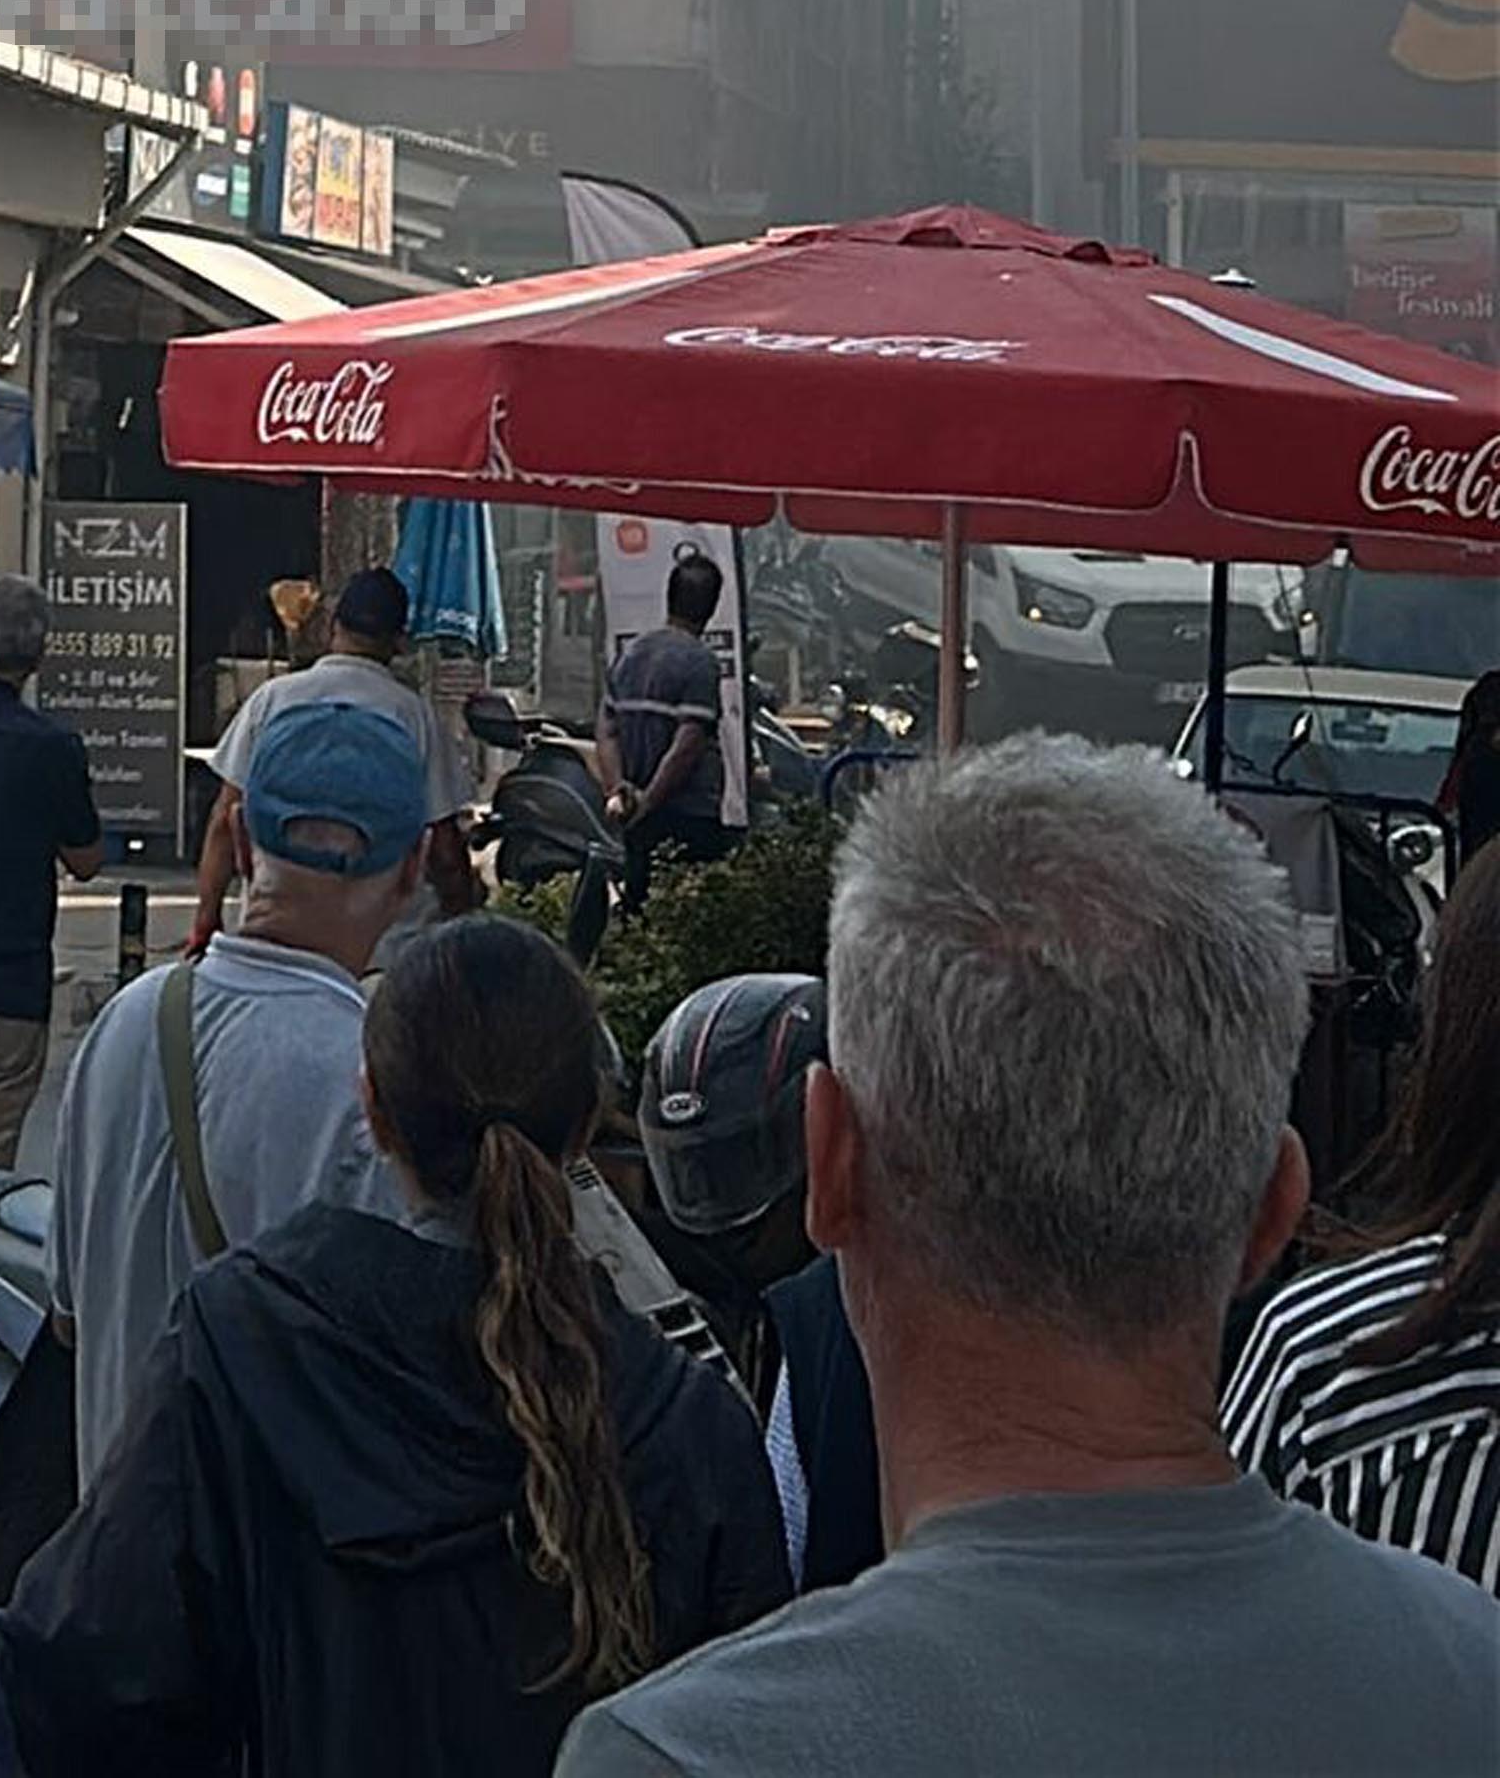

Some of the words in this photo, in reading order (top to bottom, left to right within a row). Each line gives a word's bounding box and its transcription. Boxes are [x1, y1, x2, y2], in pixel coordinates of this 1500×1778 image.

[46, 568, 174, 613] İLETİŞİM
[127, 633, 147, 658] 31
[152, 634, 175, 660] 92
